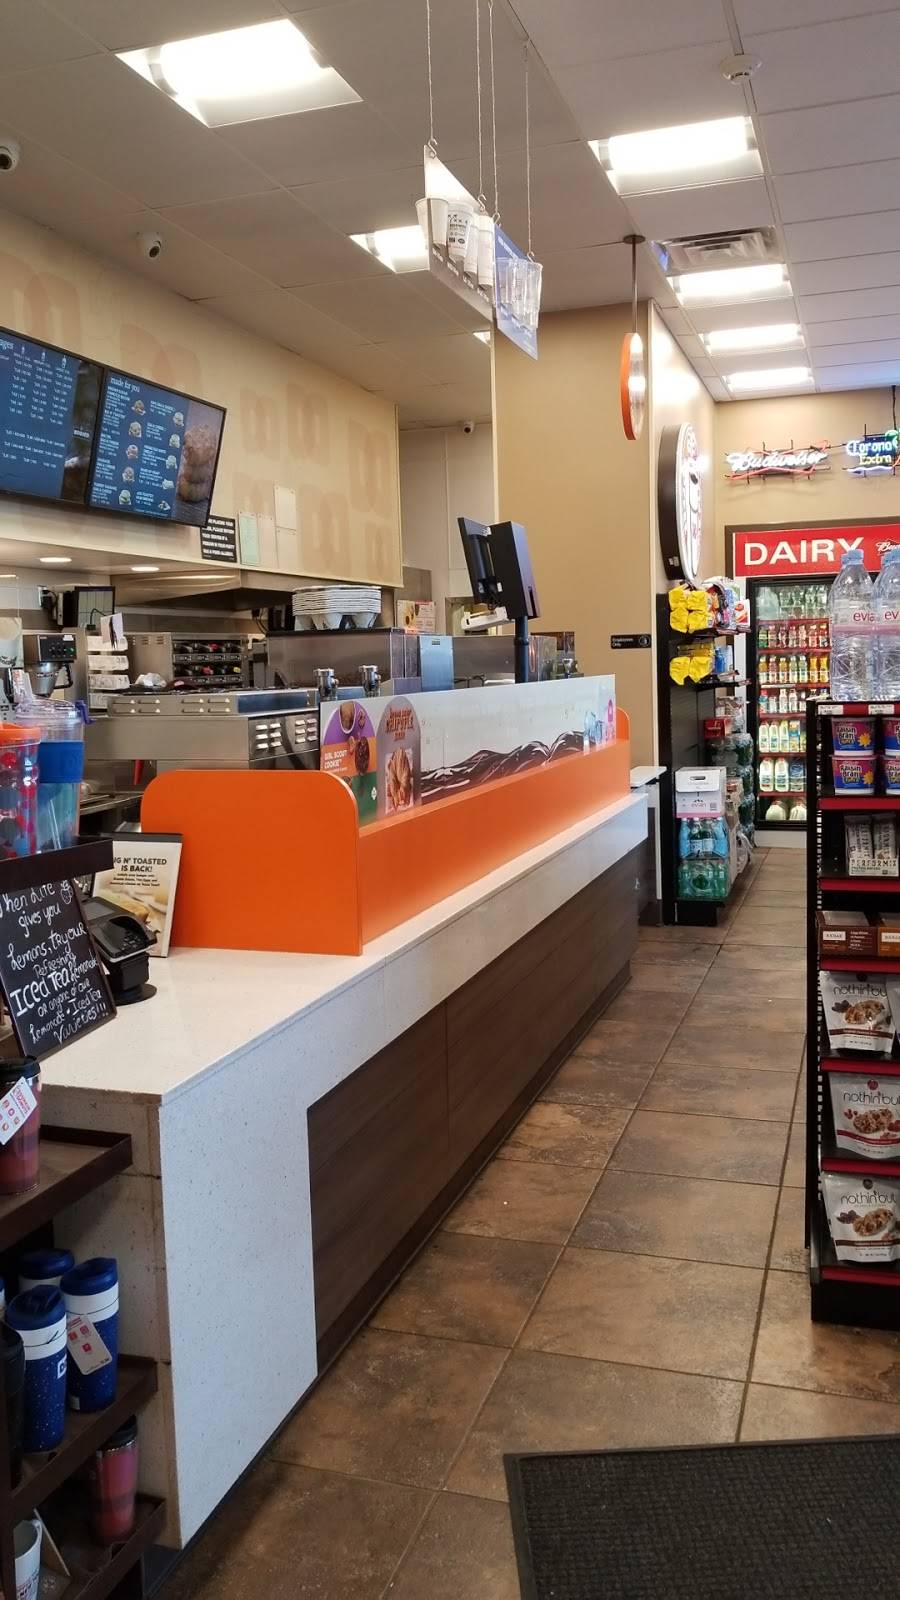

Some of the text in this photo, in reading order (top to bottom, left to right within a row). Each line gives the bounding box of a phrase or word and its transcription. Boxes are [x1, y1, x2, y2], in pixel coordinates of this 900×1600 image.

[131, 384, 140, 393] you
[726, 451, 828, 471] Budweiser
[744, 537, 864, 566] DAIRY
[853, 610, 876, 622] evia
[0, 892, 28, 918] hen
[18, 903, 62, 938] gives you
[10, 978, 51, 1017] Iced
[48, 966, 71, 993] Tea
